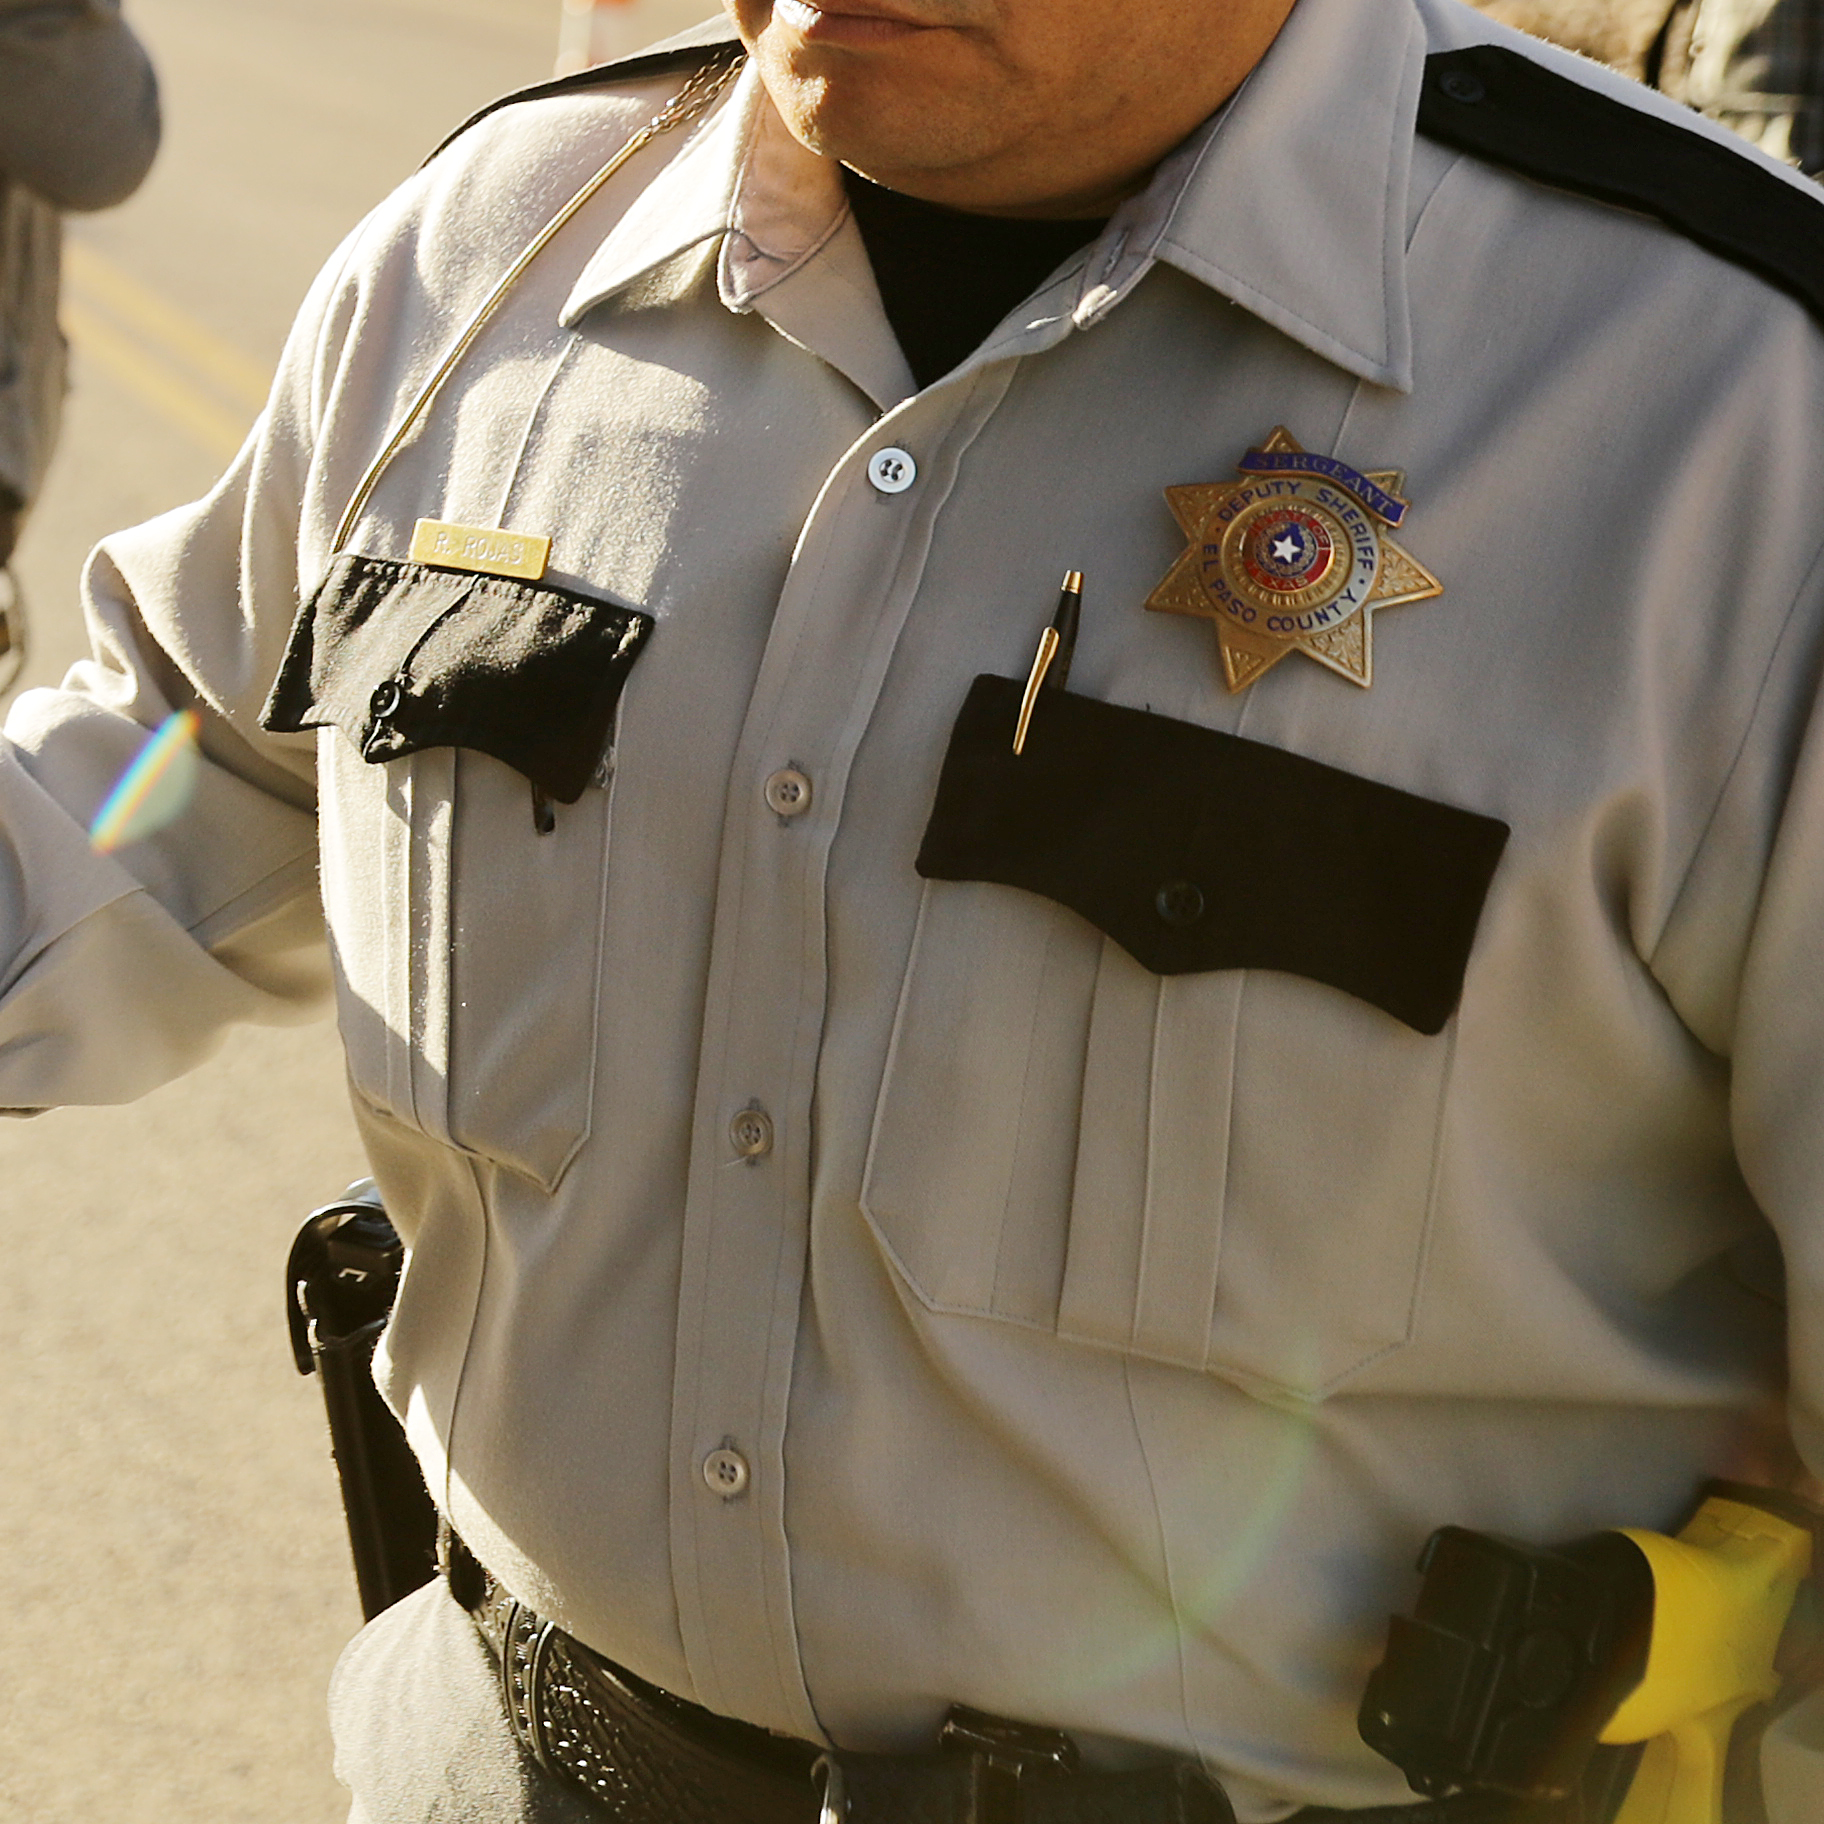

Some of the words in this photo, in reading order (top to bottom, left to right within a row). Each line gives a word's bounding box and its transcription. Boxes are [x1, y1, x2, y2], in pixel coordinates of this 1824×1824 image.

[1257, 455, 1394, 514] SERGEANT
[1218, 480, 1301, 522] DEPUTY
[1316, 488, 1375, 571] SHERIFF
[462, 536, 524, 565] ROJAS
[1204, 544, 1218, 572] EL
[1210, 579, 1257, 623] PASO
[1267, 588, 1358, 632] COUNTY
